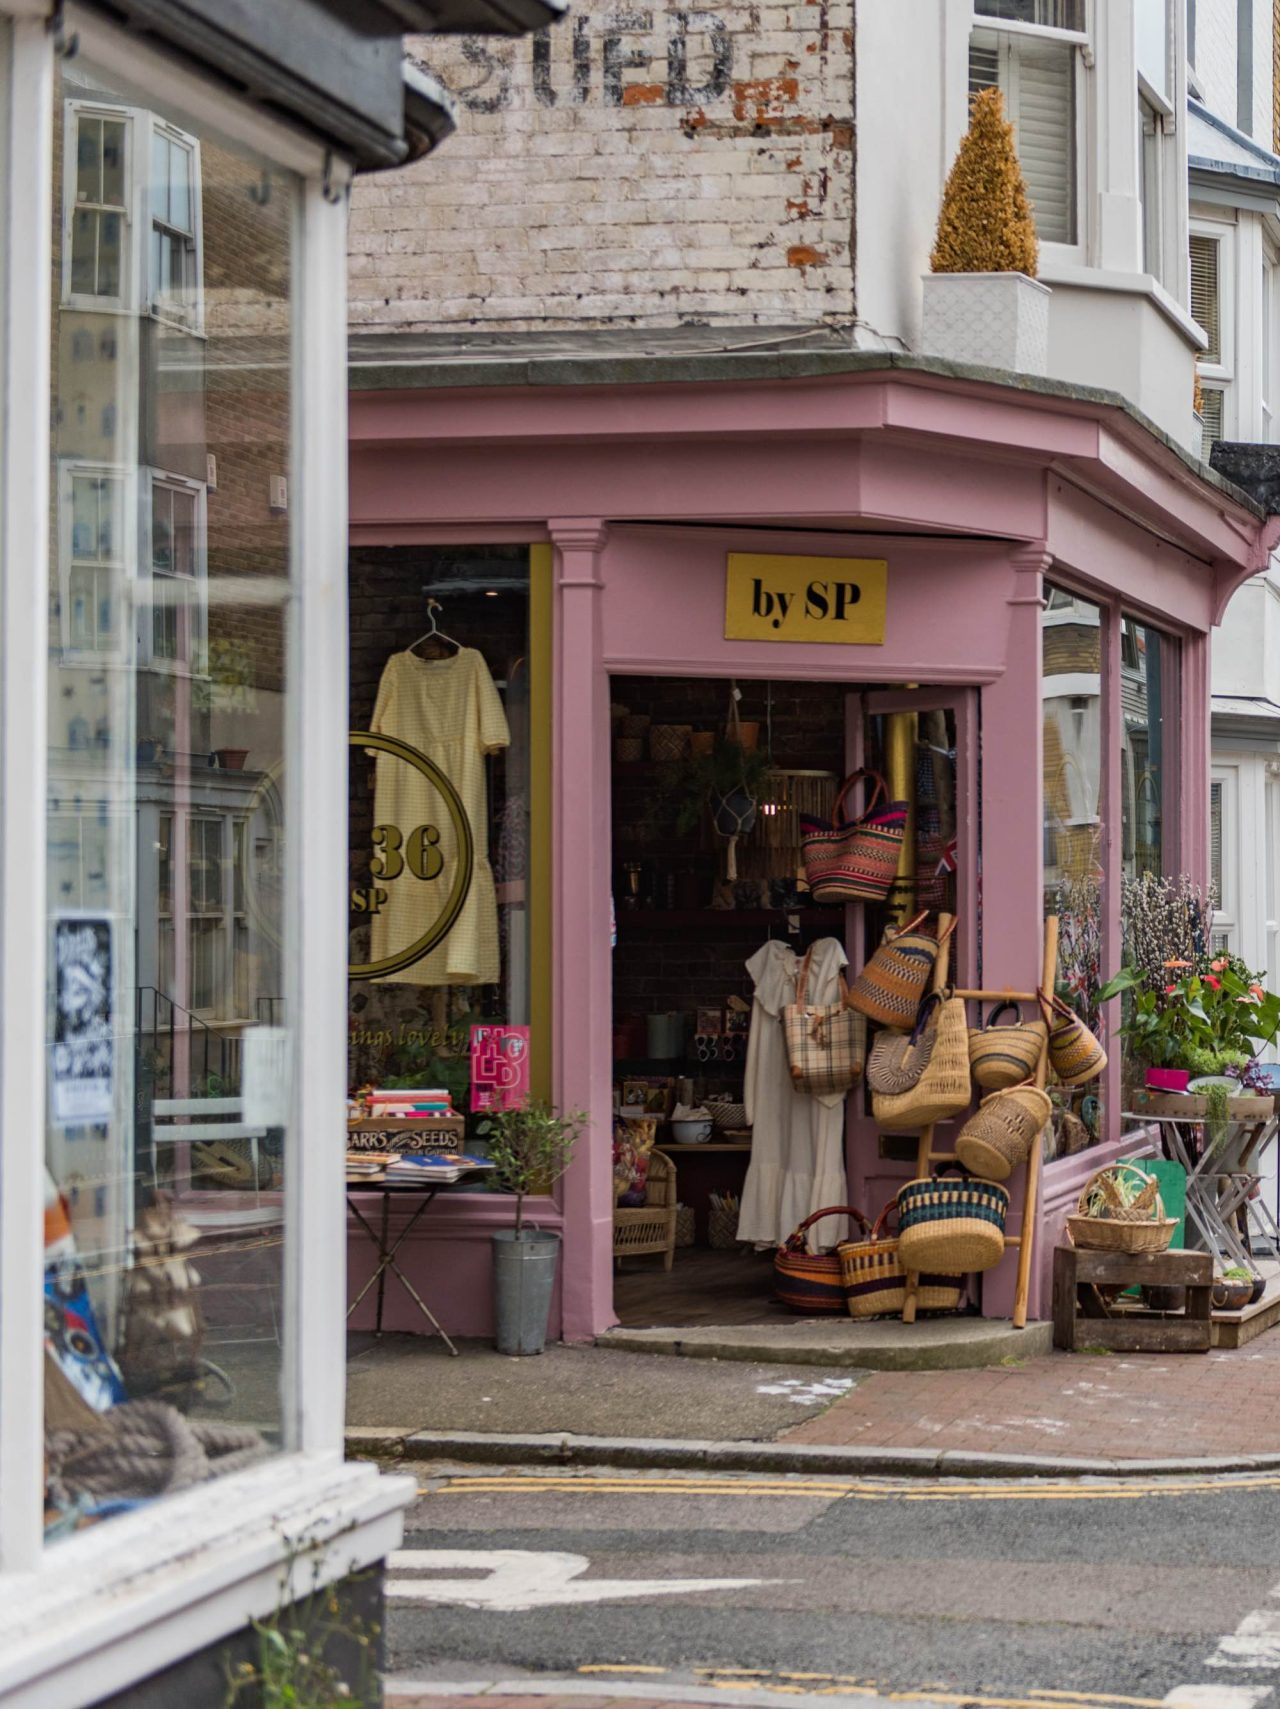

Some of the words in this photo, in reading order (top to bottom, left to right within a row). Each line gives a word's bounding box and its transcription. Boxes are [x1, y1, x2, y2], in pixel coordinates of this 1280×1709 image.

[752, 578, 796, 628] by
[805, 580, 861, 620] SP
[370, 824, 444, 880] 36
[352, 888, 387, 914] SP
[411, 1131, 458, 1149] SEEDS
